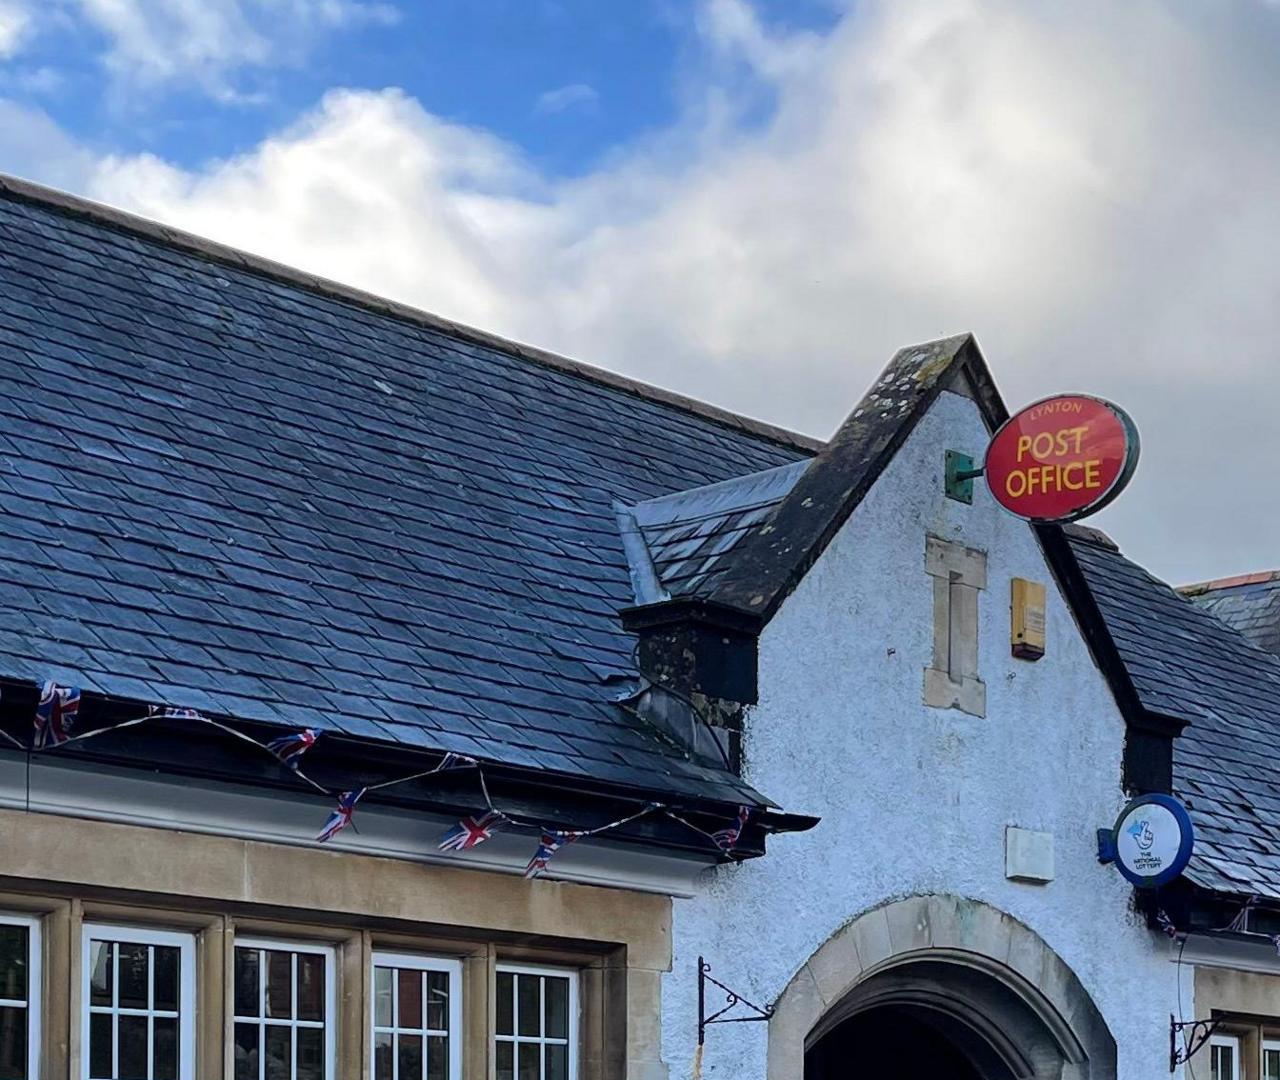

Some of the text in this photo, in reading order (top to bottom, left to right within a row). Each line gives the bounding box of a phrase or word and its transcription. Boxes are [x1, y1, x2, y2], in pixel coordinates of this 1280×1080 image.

[1030, 402, 1082, 420] LYNTON
[1017, 426, 1089, 462] POST
[1005, 460, 1101, 498] OFFICE
